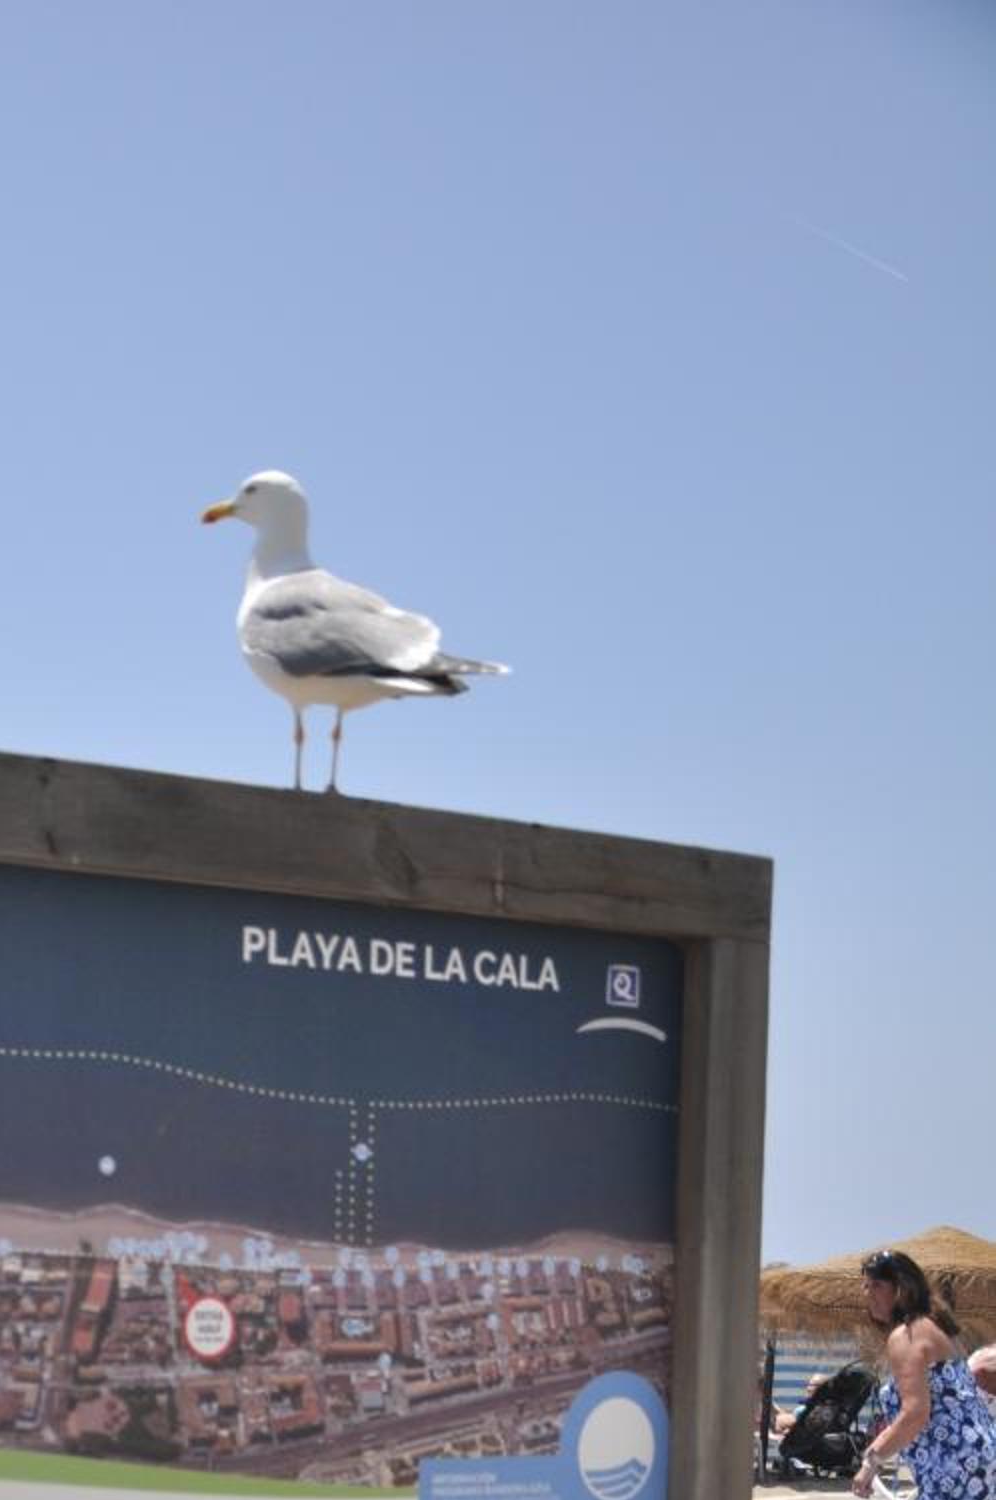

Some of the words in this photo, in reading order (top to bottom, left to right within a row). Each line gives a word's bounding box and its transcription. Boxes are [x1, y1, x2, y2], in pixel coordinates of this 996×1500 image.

[241, 925, 363, 974] PLAYA
[369, 938, 416, 978] DE
[424, 945, 467, 983] LA
[473, 950, 560, 993] CALA
